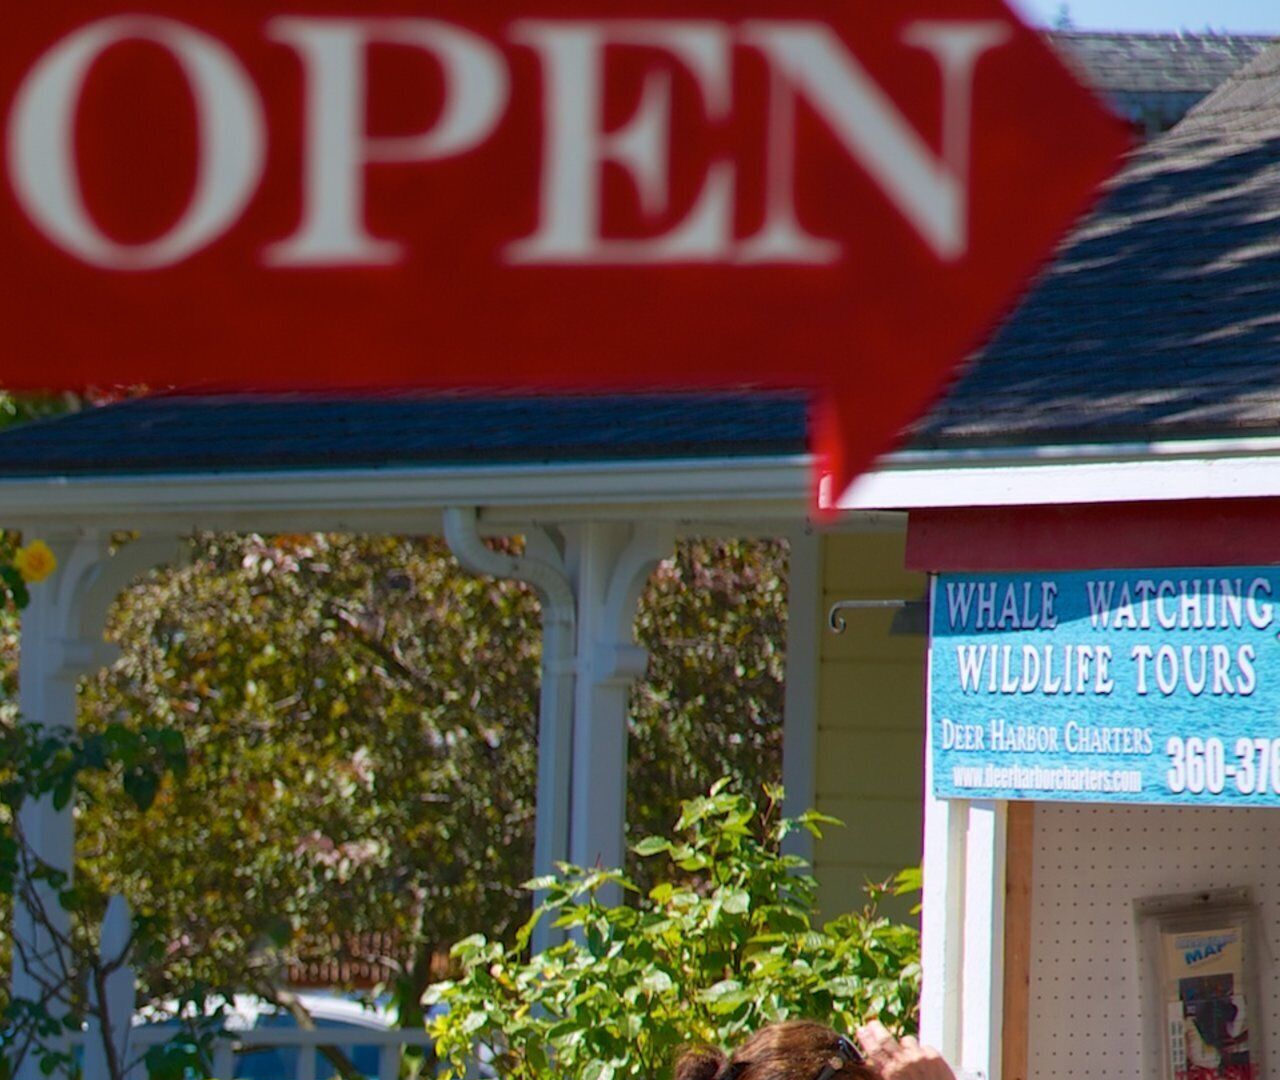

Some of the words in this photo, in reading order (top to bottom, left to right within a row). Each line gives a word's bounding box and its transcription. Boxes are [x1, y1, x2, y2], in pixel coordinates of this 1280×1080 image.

[6, 13, 1013, 272] OPEN
[946, 581, 1058, 630] WHALE
[1087, 576, 1274, 631] WATCHING
[956, 644, 1115, 695] WILDLIFE
[1131, 643, 1257, 696] TOURS
